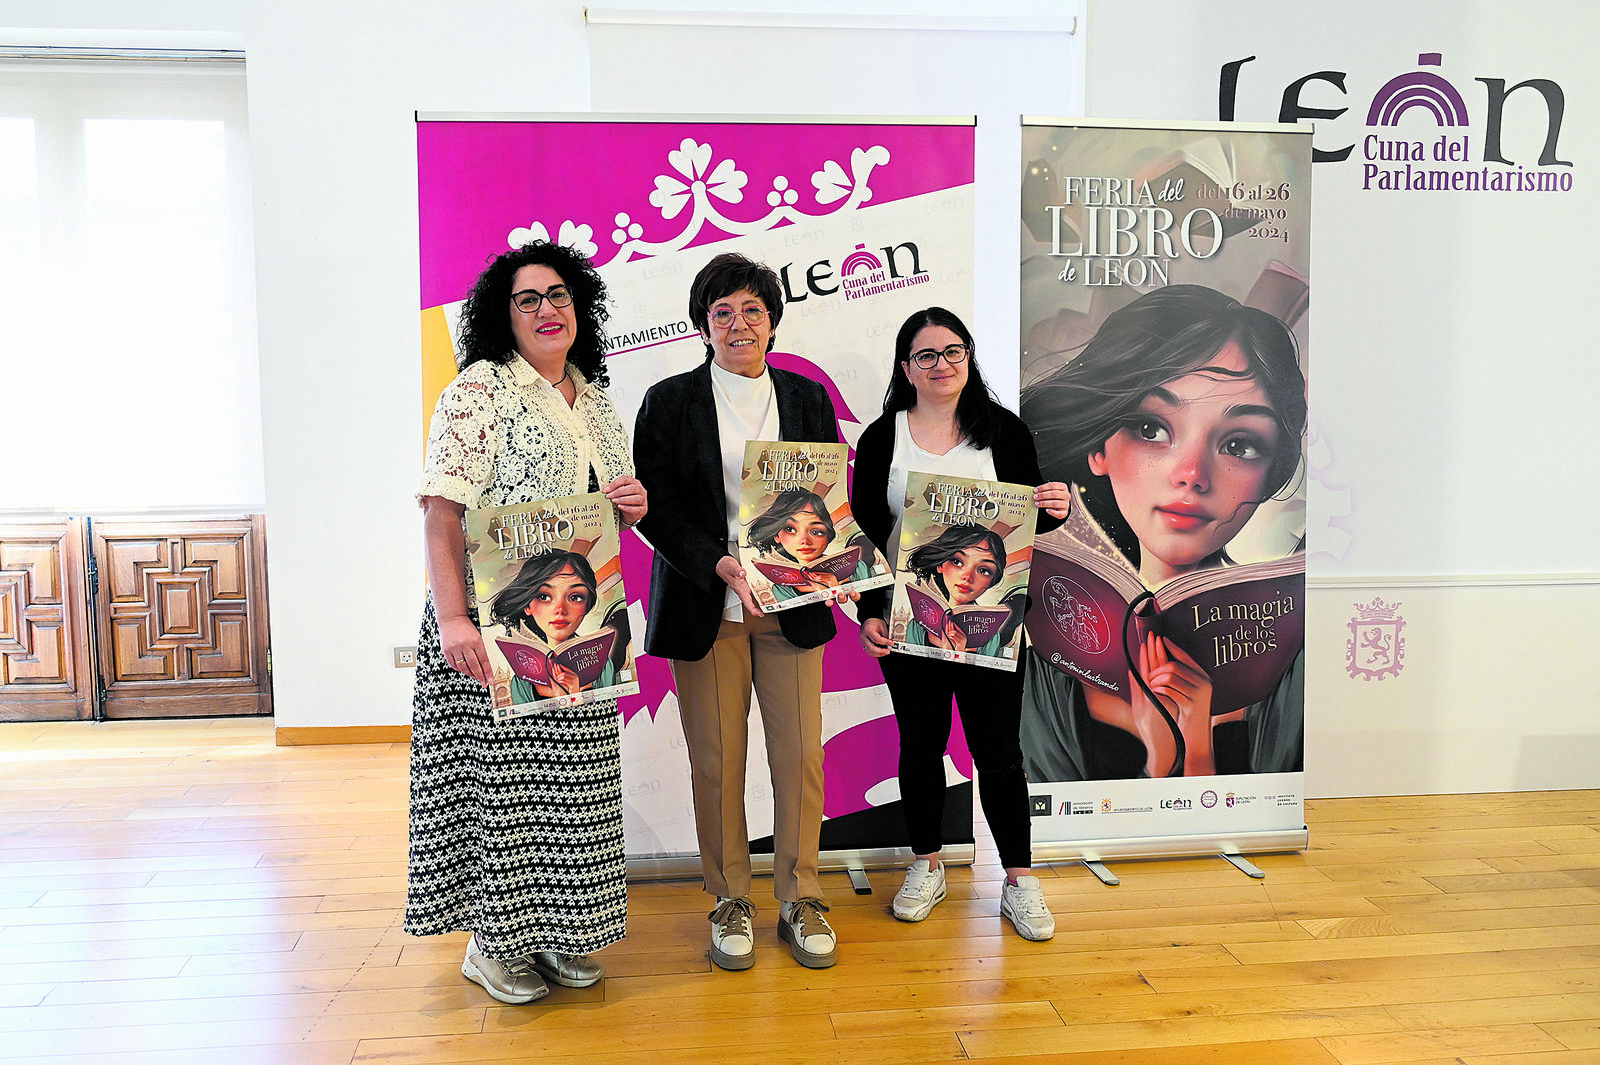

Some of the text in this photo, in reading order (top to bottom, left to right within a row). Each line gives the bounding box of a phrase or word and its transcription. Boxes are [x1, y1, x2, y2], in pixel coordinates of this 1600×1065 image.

[1364, 134, 1470, 162] Cuna del
[1362, 164, 1573, 192] Parlamentarismo
[1063, 177, 1185, 206] FERIA del
[1197, 182, 1290, 201] del 16 al 26
[1224, 204, 1287, 225] de mayo
[1045, 206, 1223, 259] LIBRO
[1248, 227, 1289, 243] 2024
[1058, 259, 1076, 282] de
[842, 271, 886, 290] Cuna del
[844, 274, 930, 301] Parlamentarismo
[605, 321, 688, 349] NTAMIENTO
[769, 450, 797, 461] FERIA
[817, 451, 826, 459] 16
[762, 461, 818, 482] LIBRO
[937, 483, 987, 497] FERIA del
[999, 491, 1009, 500] 16
[558, 503, 600, 515] del 16 al 26
[928, 492, 999, 519] LIBRO
[501, 509, 555, 527] FERIA del
[581, 513, 600, 522] mayo
[495, 518, 574, 550] LIBRO
[504, 550, 513, 560] de
[963, 614, 996, 625] La magia
[1192, 591, 1295, 632] La magia
[968, 625, 989, 634] libros
[1235, 624, 1275, 641] de los
[567, 642, 603, 660] La magia
[1213, 635, 1278, 668] libros
[576, 658, 599, 672] libros
